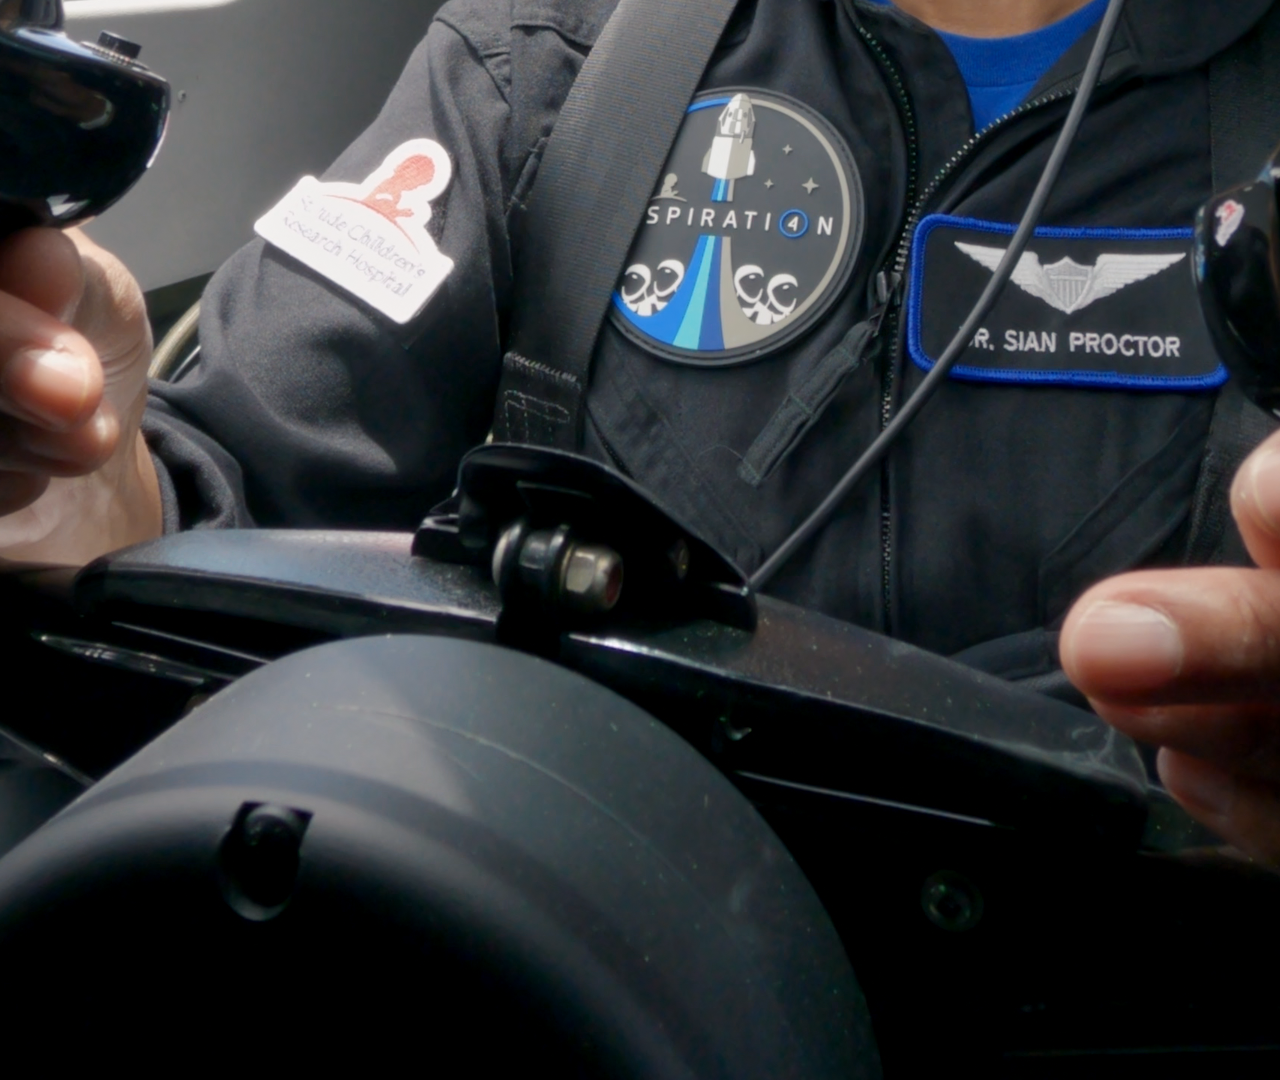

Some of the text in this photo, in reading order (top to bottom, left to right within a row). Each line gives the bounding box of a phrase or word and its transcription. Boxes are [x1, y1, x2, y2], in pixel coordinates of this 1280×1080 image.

[345, 248, 413, 297] Hospital
[966, 327, 1181, 358] R. SIAN PROCTOR
